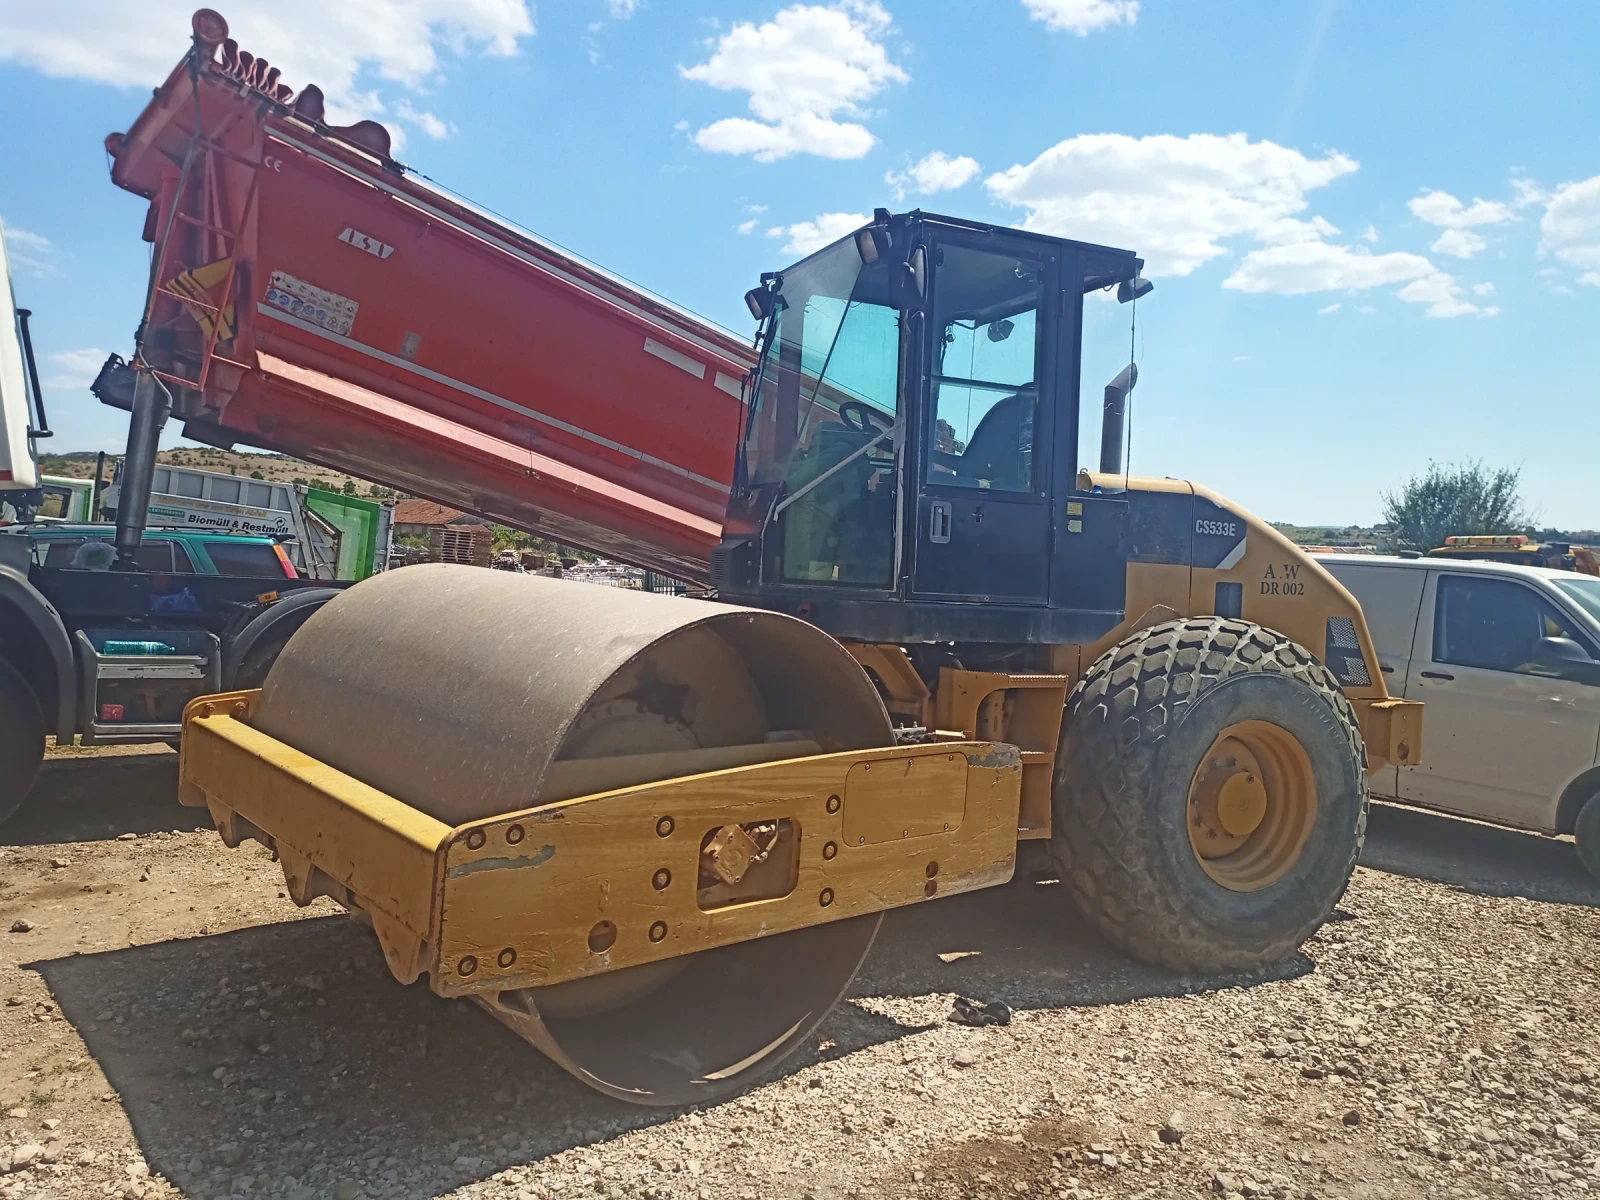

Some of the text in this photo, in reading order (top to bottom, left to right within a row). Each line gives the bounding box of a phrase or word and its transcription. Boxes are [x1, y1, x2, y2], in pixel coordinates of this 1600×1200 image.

[188, 514, 231, 528] Biomüll
[232, 520, 239, 529] &
[242, 522, 289, 534] Restmüll
[1195, 519, 1236, 537] CS533E
[1260, 581, 1305, 596] DR 002
